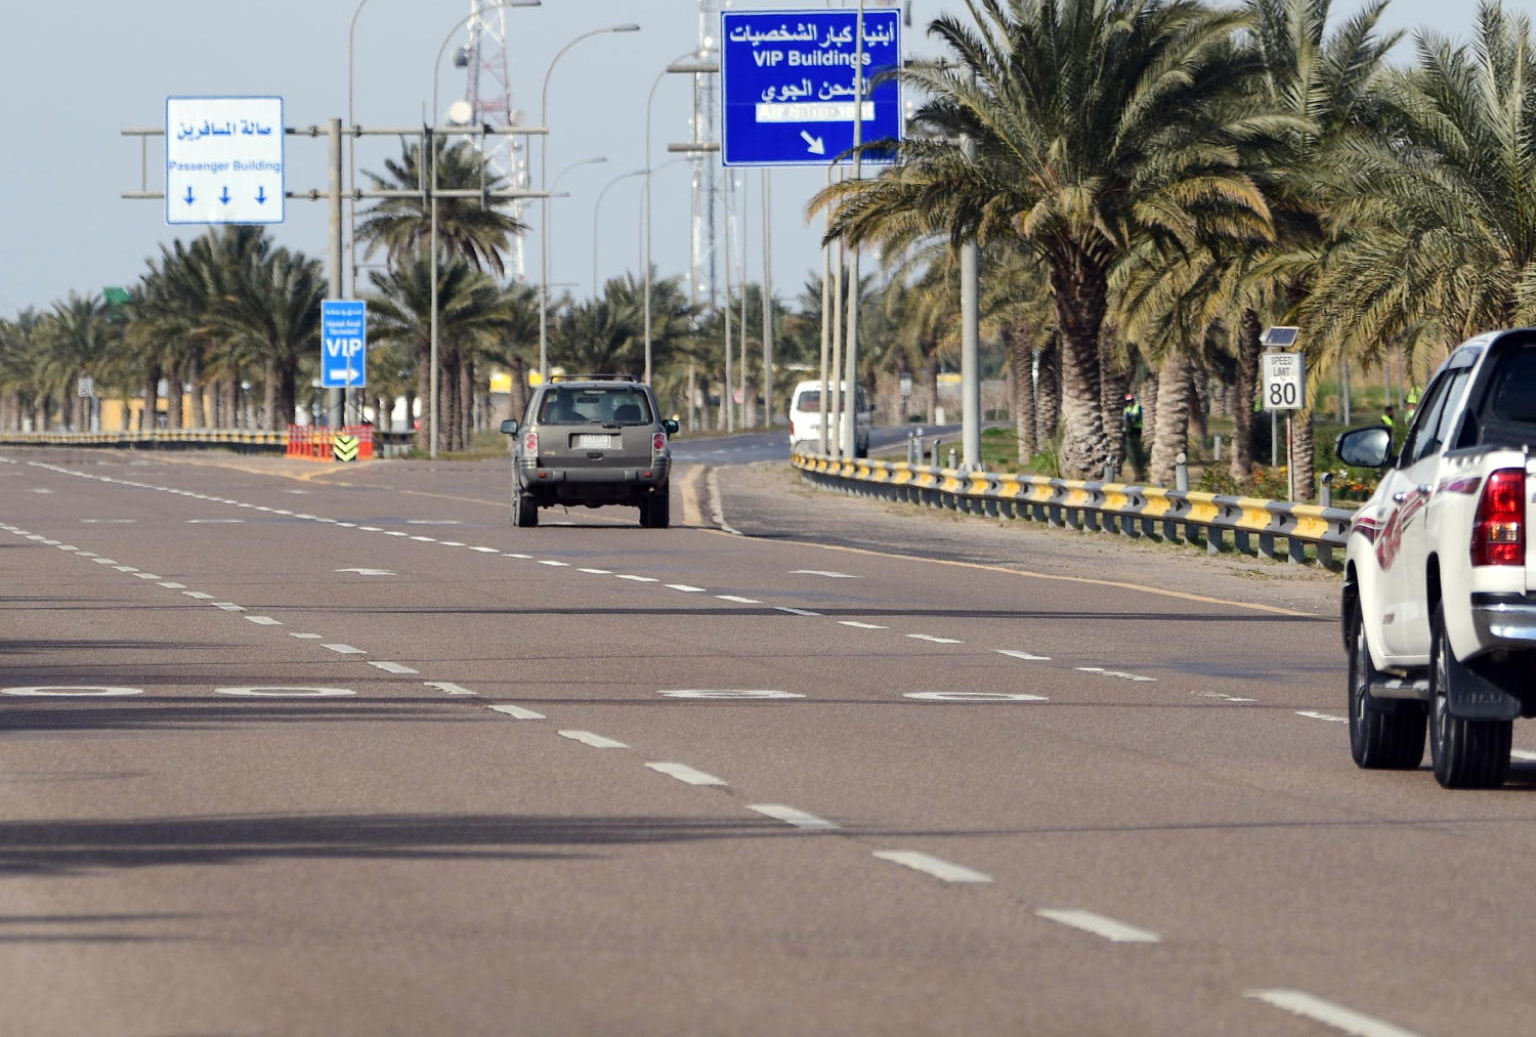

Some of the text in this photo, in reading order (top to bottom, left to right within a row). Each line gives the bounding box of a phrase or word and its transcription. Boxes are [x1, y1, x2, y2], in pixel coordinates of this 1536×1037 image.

[862, 21, 894, 48] أبني
[753, 50, 784, 67] VIP
[168, 160, 230, 174] Passenger
[326, 338, 362, 358] VIP
[1271, 356, 1293, 366] SPEED
[1273, 366, 1291, 377] LIMIT
[1270, 382, 1297, 405] 80
